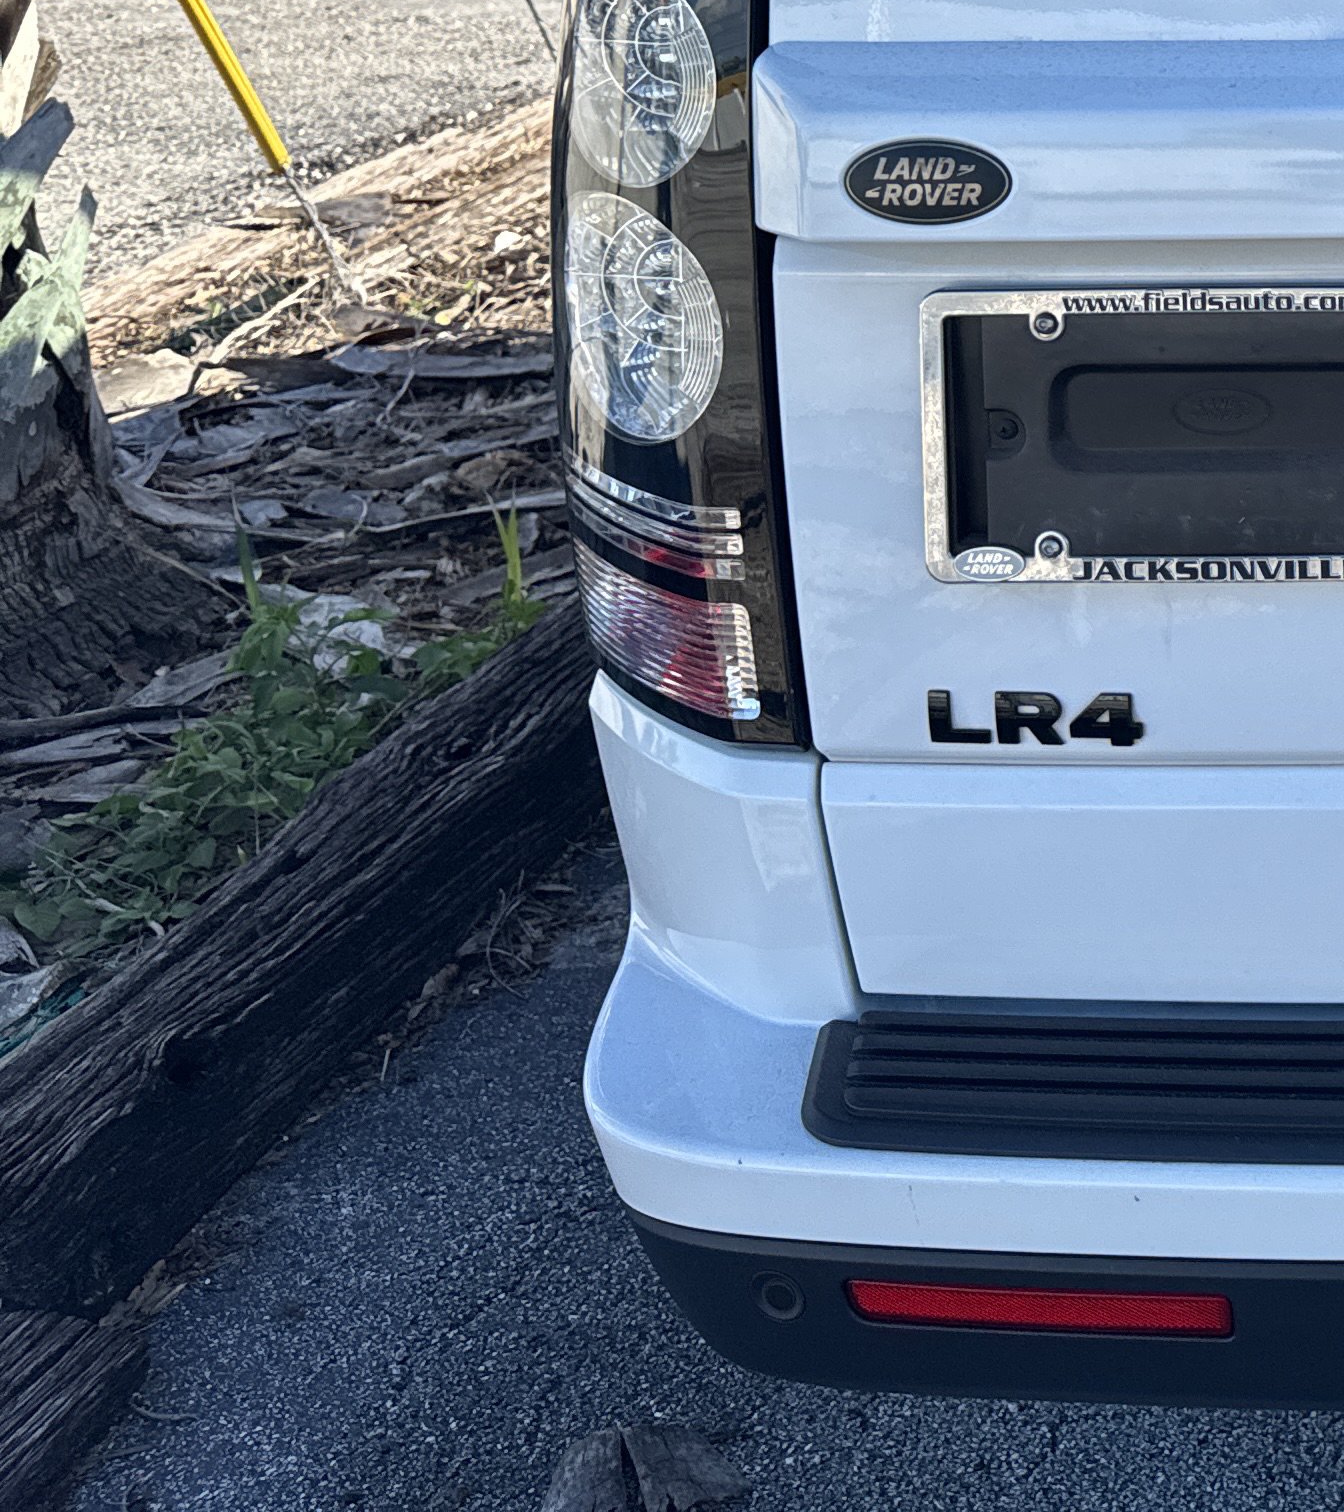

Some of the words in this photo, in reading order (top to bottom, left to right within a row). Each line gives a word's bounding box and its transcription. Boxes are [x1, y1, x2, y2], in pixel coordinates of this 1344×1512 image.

[873, 157, 956, 181] LAND
[881, 183, 982, 207] ROVER
[967, 552, 1003, 564] LAND
[970, 564, 1014, 575] ROVER
[927, 689, 1144, 747] LR4
